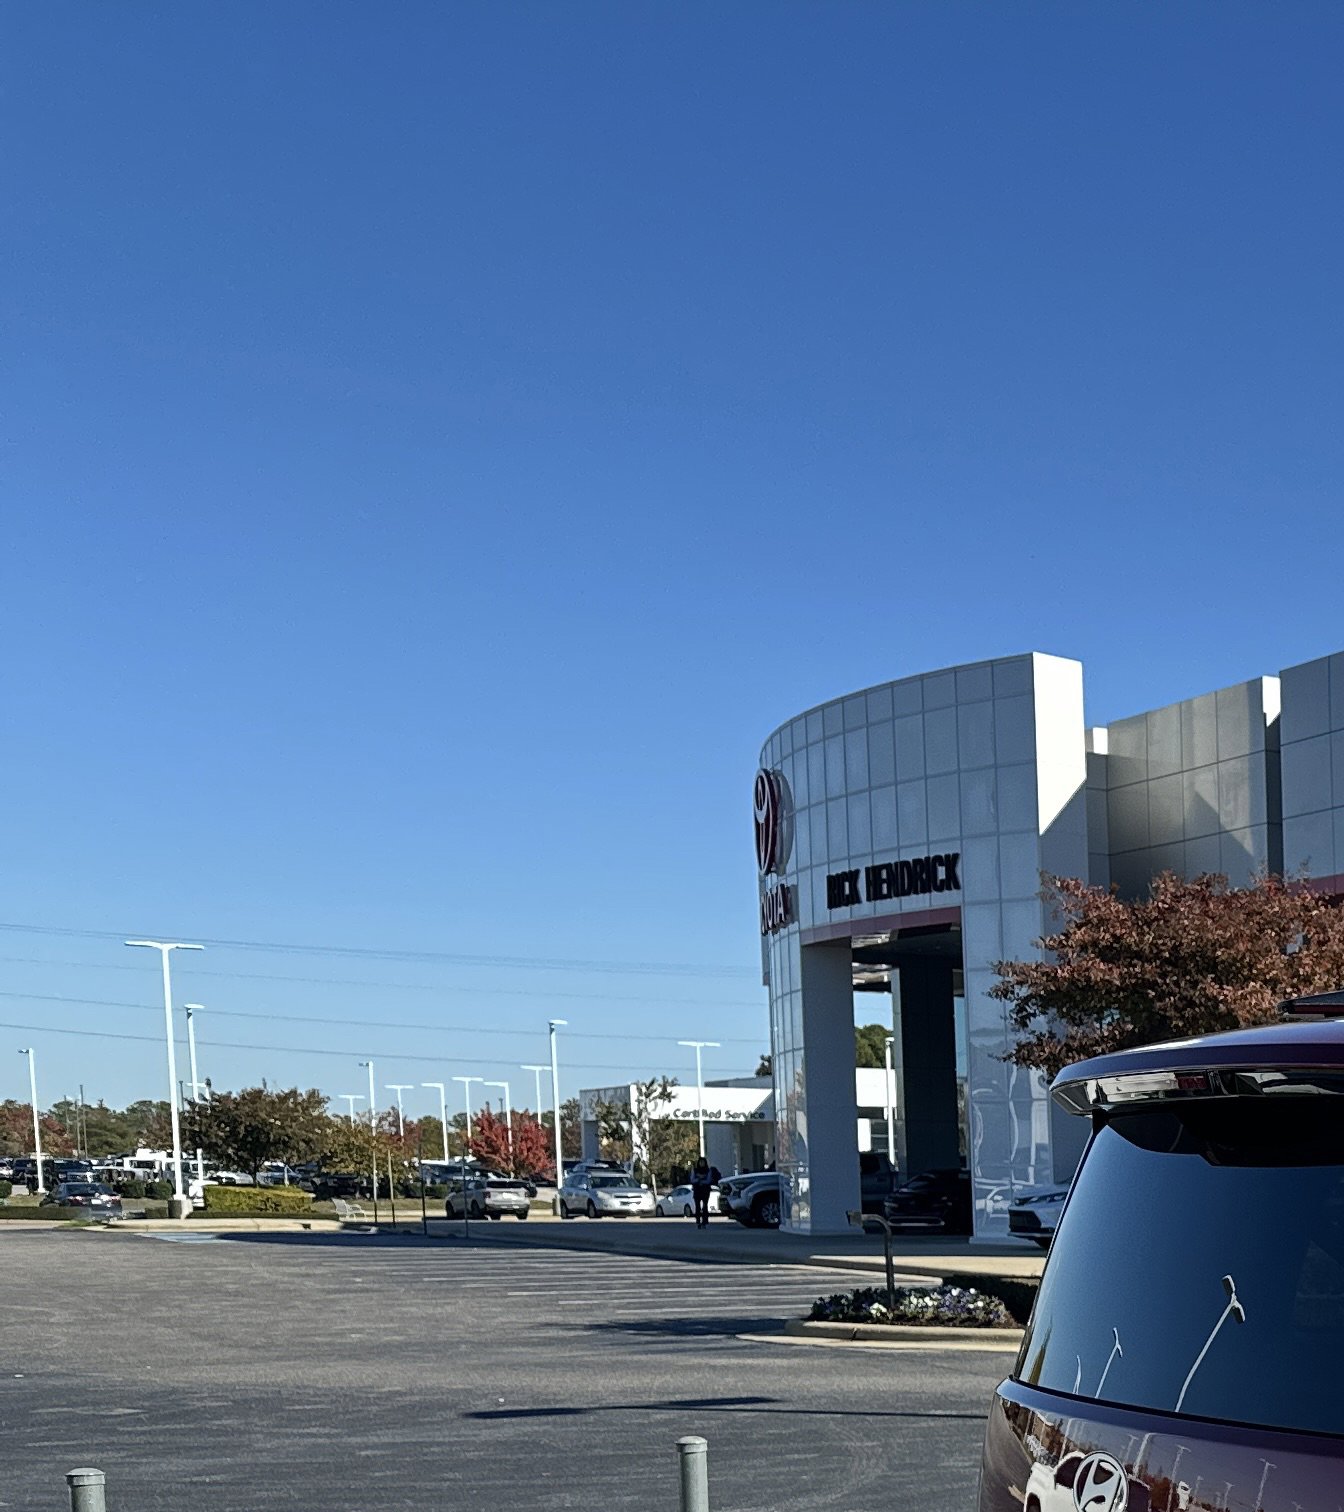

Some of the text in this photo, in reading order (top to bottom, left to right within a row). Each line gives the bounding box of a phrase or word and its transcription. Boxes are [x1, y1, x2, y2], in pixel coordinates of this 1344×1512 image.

[826, 853, 961, 910] RICK HENDRICK
[725, 1109, 765, 1120] Service
